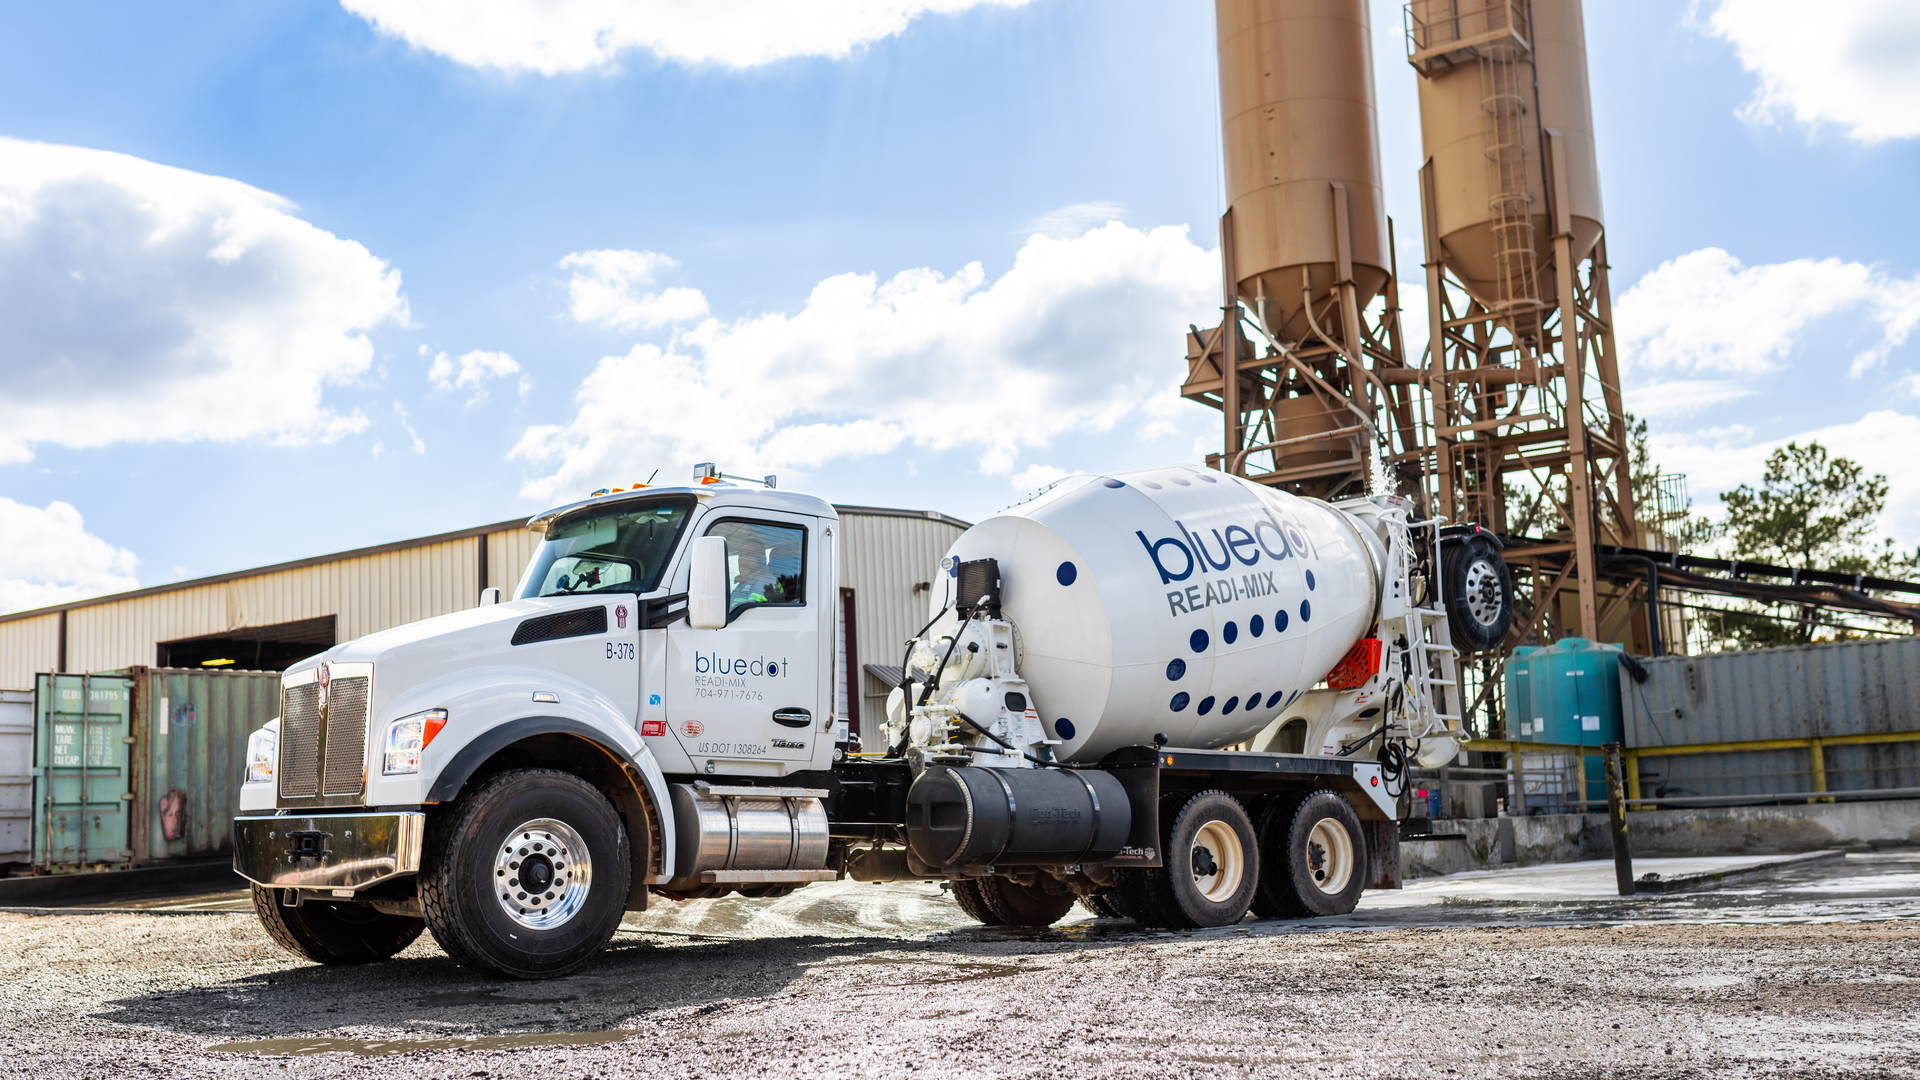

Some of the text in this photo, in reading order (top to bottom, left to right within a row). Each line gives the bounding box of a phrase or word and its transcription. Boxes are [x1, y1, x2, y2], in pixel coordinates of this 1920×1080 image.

[1135, 508, 1319, 585] bluedot
[1166, 571, 1279, 617] READI-MIX
[606, 642, 635, 660] B-378
[695, 651, 788, 678] bluedot
[694, 676, 746, 688] READI-MIX
[90, 690, 118, 701] 301795
[695, 688, 763, 701] 704-971-7676
[698, 742, 767, 755] US DOT 1308264
